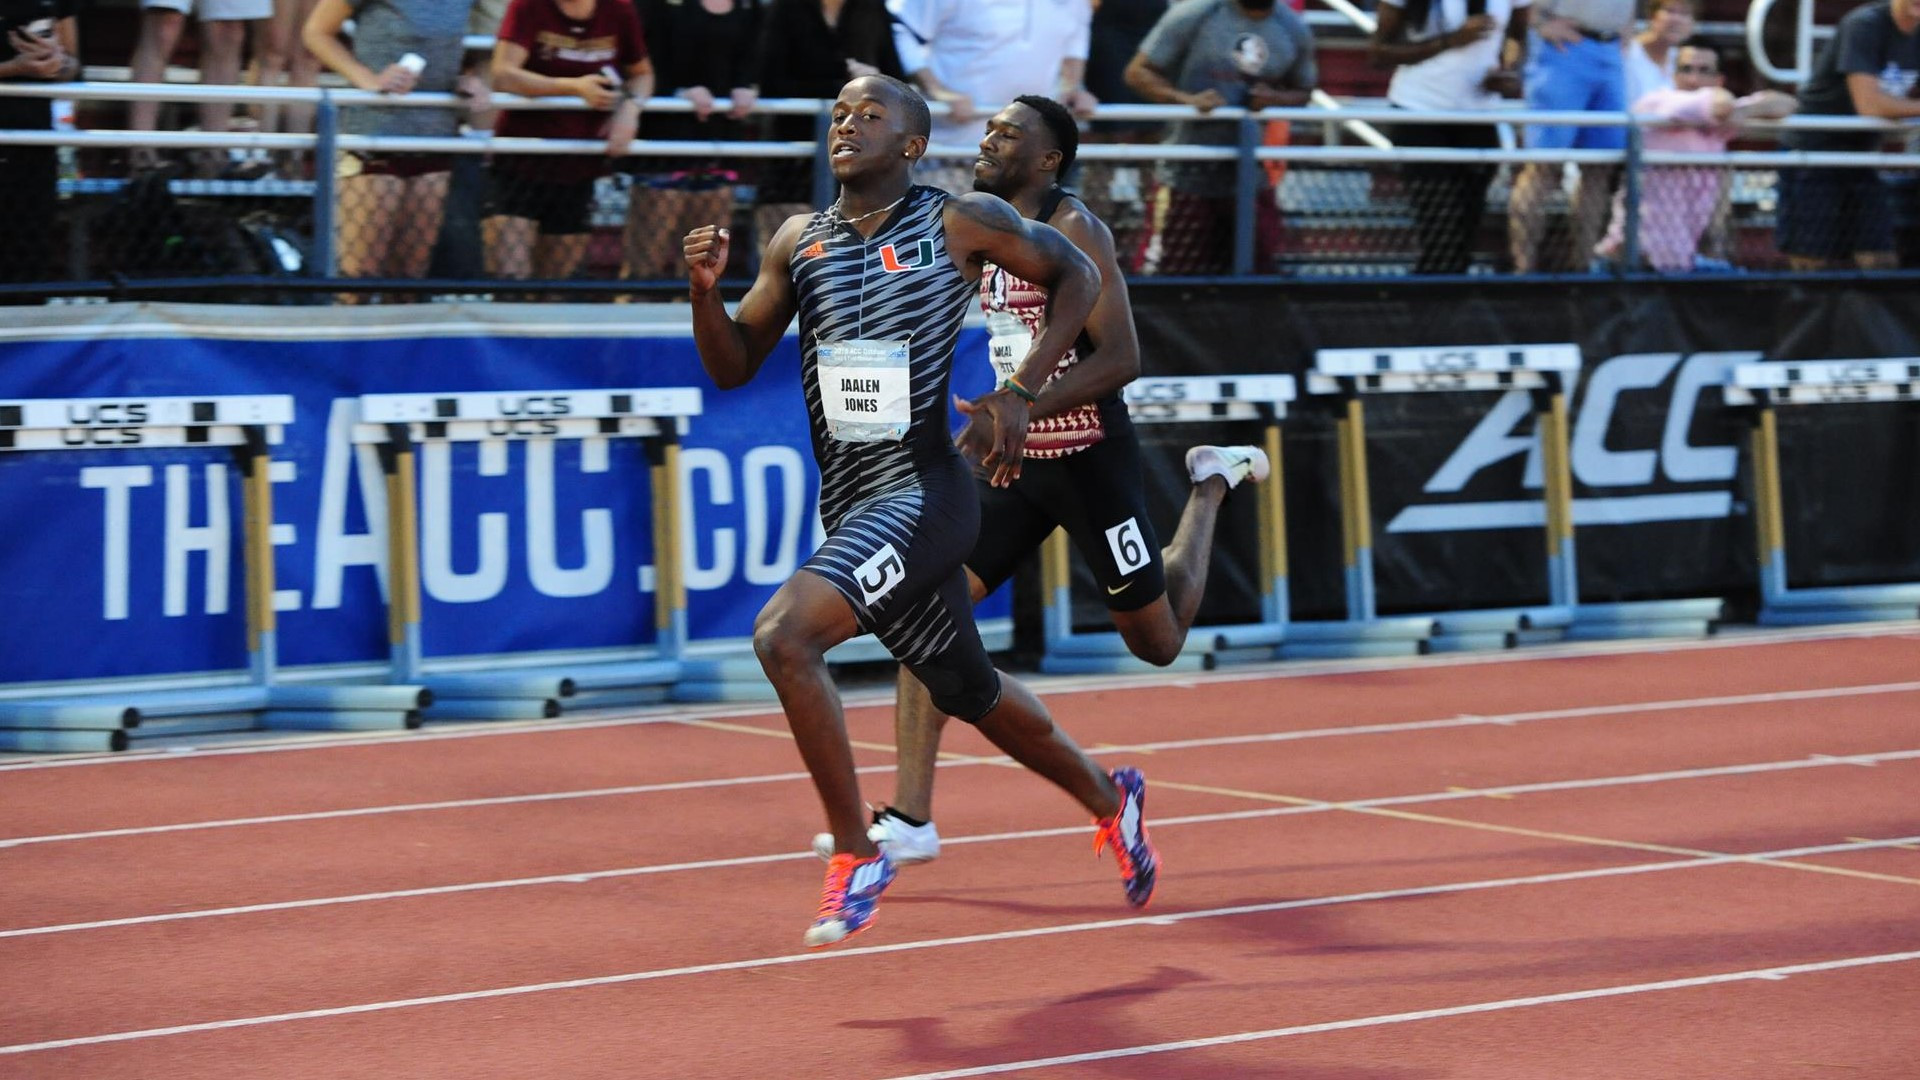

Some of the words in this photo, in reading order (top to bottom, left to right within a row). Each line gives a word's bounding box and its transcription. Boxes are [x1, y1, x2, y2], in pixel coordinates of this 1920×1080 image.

[878, 238, 936, 273] U
[1420, 352, 1477, 371] UCS
[841, 378, 880, 393] JAALEN
[66, 403, 148, 425] UCS
[497, 396, 571, 416] UCS
[845, 398, 878, 412] JONES
[486, 418, 559, 436] UCS
[1422, 351, 1764, 493] ACC
[60, 426, 142, 445] UCS
[79, 397, 828, 620] THEACC.CO
[1117, 524, 1142, 567] 6
[860, 554, 901, 594] 5
